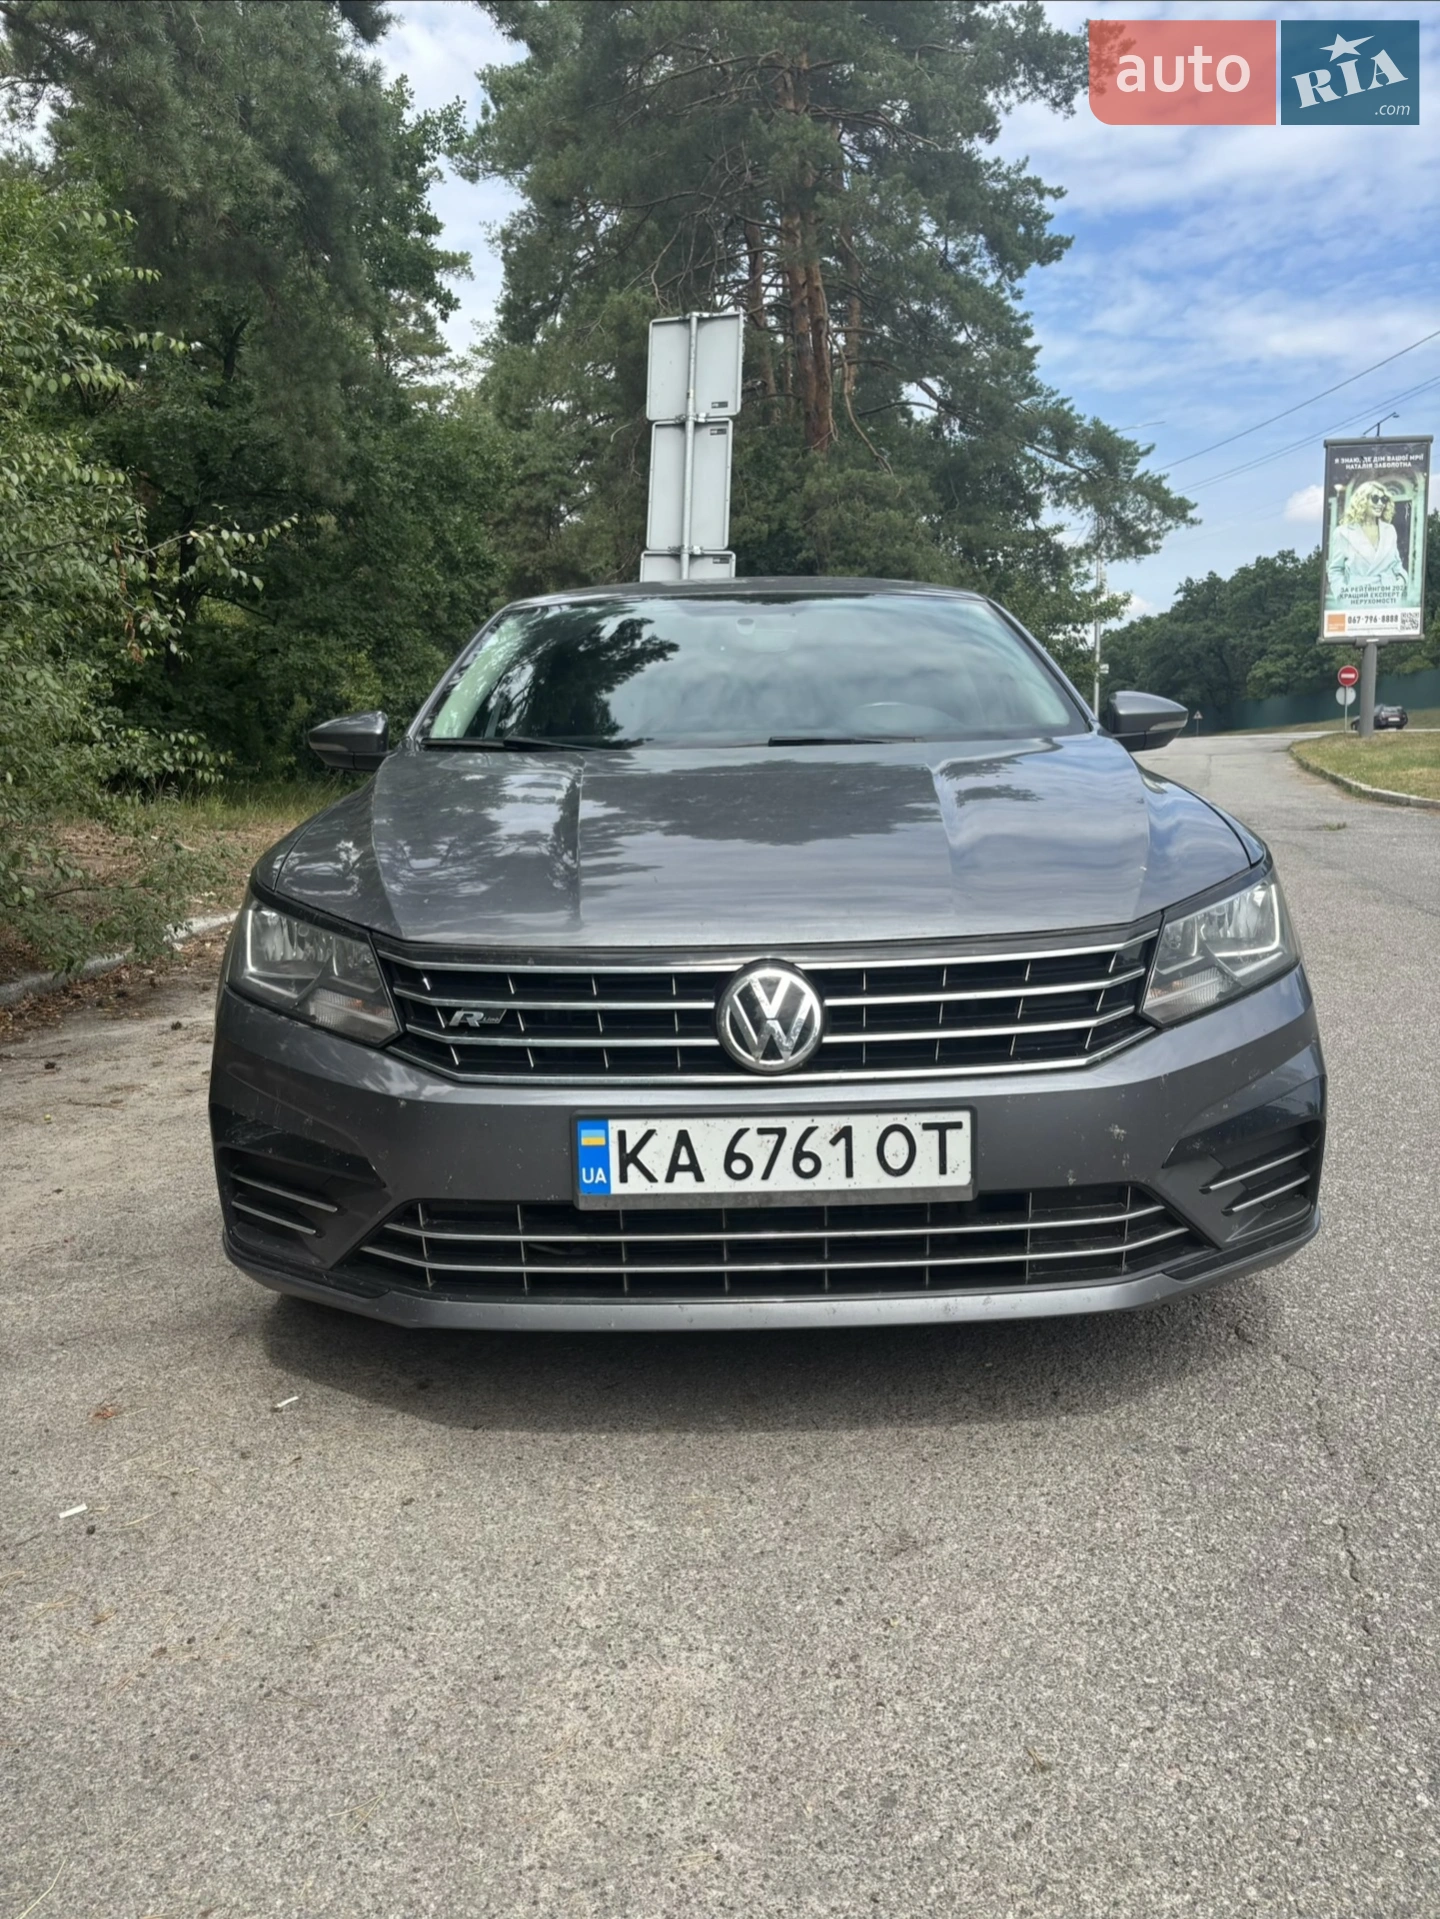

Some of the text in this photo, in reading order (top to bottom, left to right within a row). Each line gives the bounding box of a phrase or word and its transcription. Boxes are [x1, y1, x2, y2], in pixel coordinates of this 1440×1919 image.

[617, 1121, 963, 1183] KA 6761 OT
[582, 1167, 607, 1184] UA
